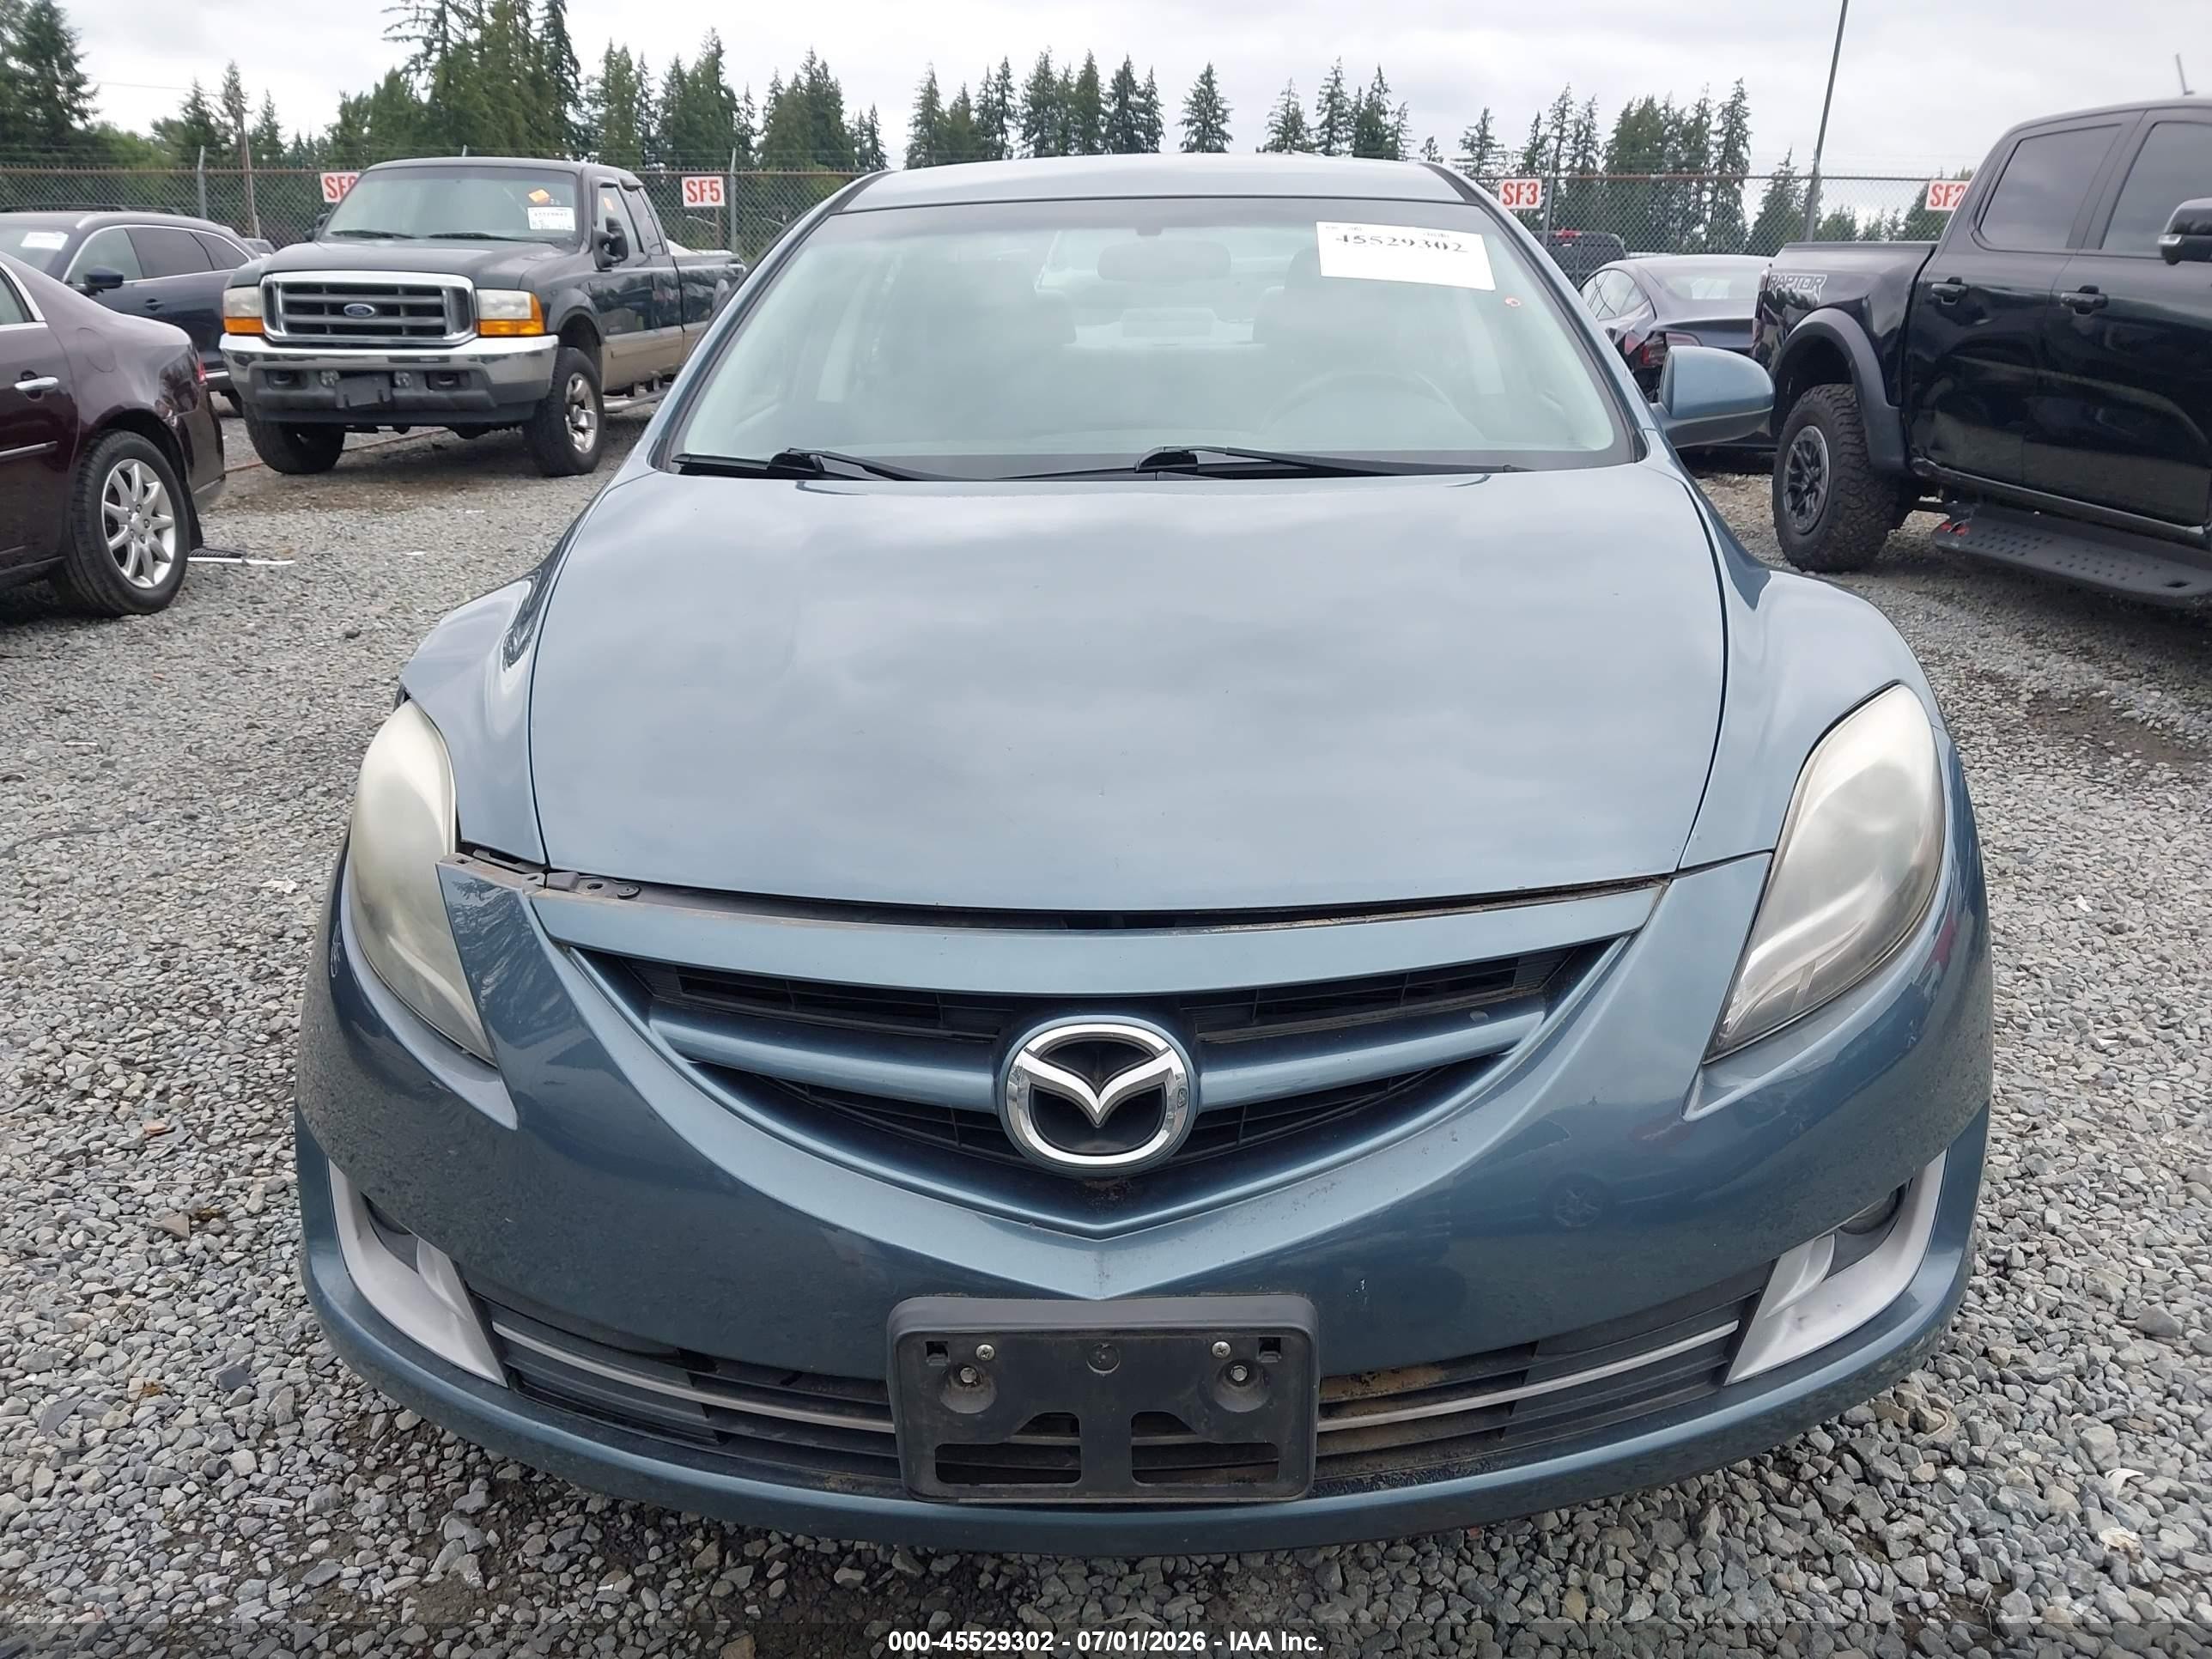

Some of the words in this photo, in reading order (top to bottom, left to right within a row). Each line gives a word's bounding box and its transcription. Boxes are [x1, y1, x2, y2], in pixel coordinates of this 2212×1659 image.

[686, 179, 720, 203] SF5
[1503, 182, 1538, 205] SF3
[1930, 183, 1966, 207] SF2
[1335, 234, 1468, 253] 45529302
[1767, 274, 1827, 302] RAPTOR
